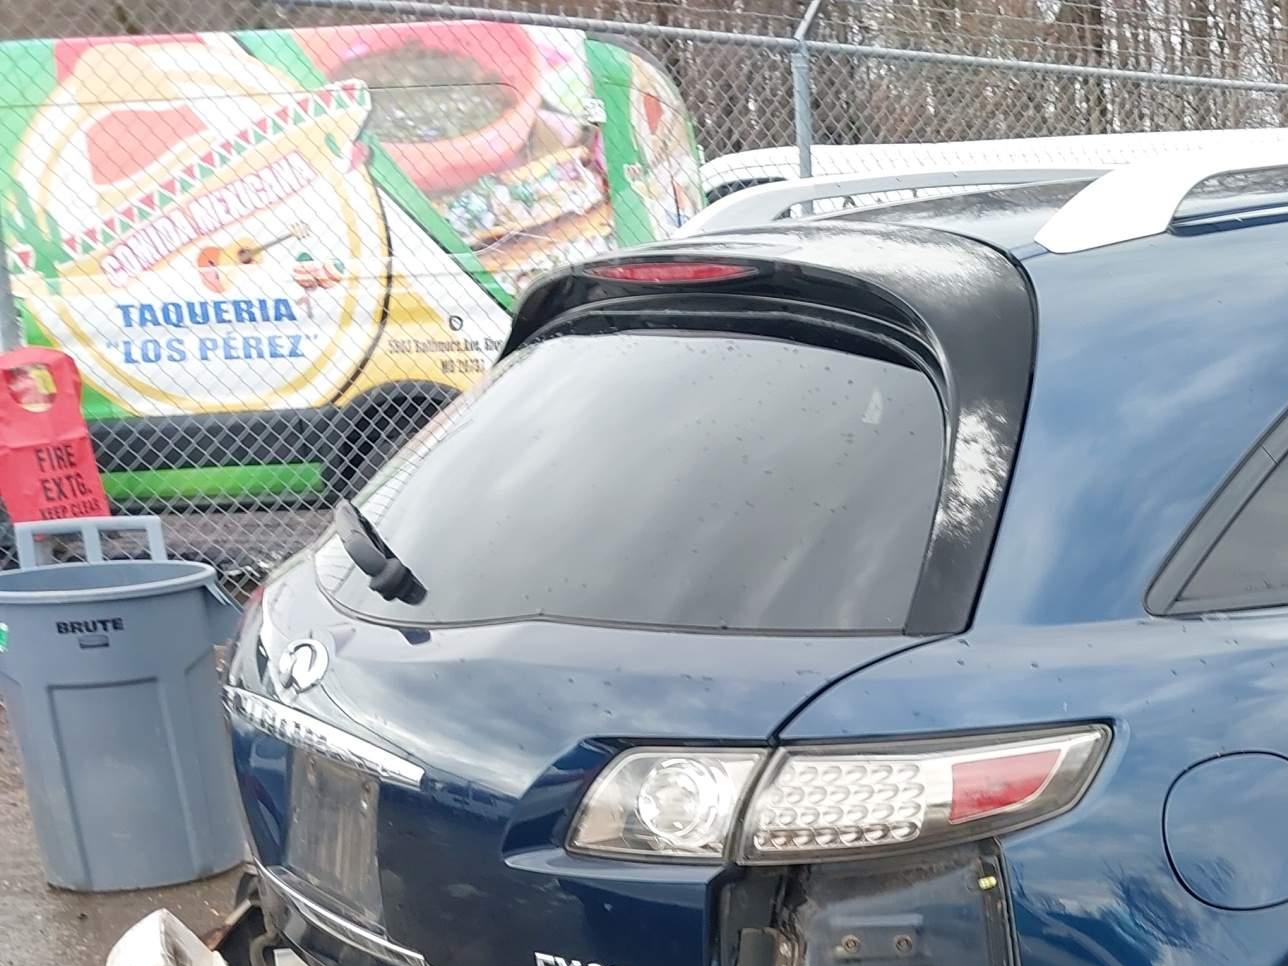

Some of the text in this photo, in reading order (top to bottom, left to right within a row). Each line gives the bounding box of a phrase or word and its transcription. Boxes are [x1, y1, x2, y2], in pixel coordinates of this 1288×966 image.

[116, 299, 297, 328] TAQUERIA
[35, 444, 77, 473] FIRE
[56, 617, 124, 633] BRUTE
